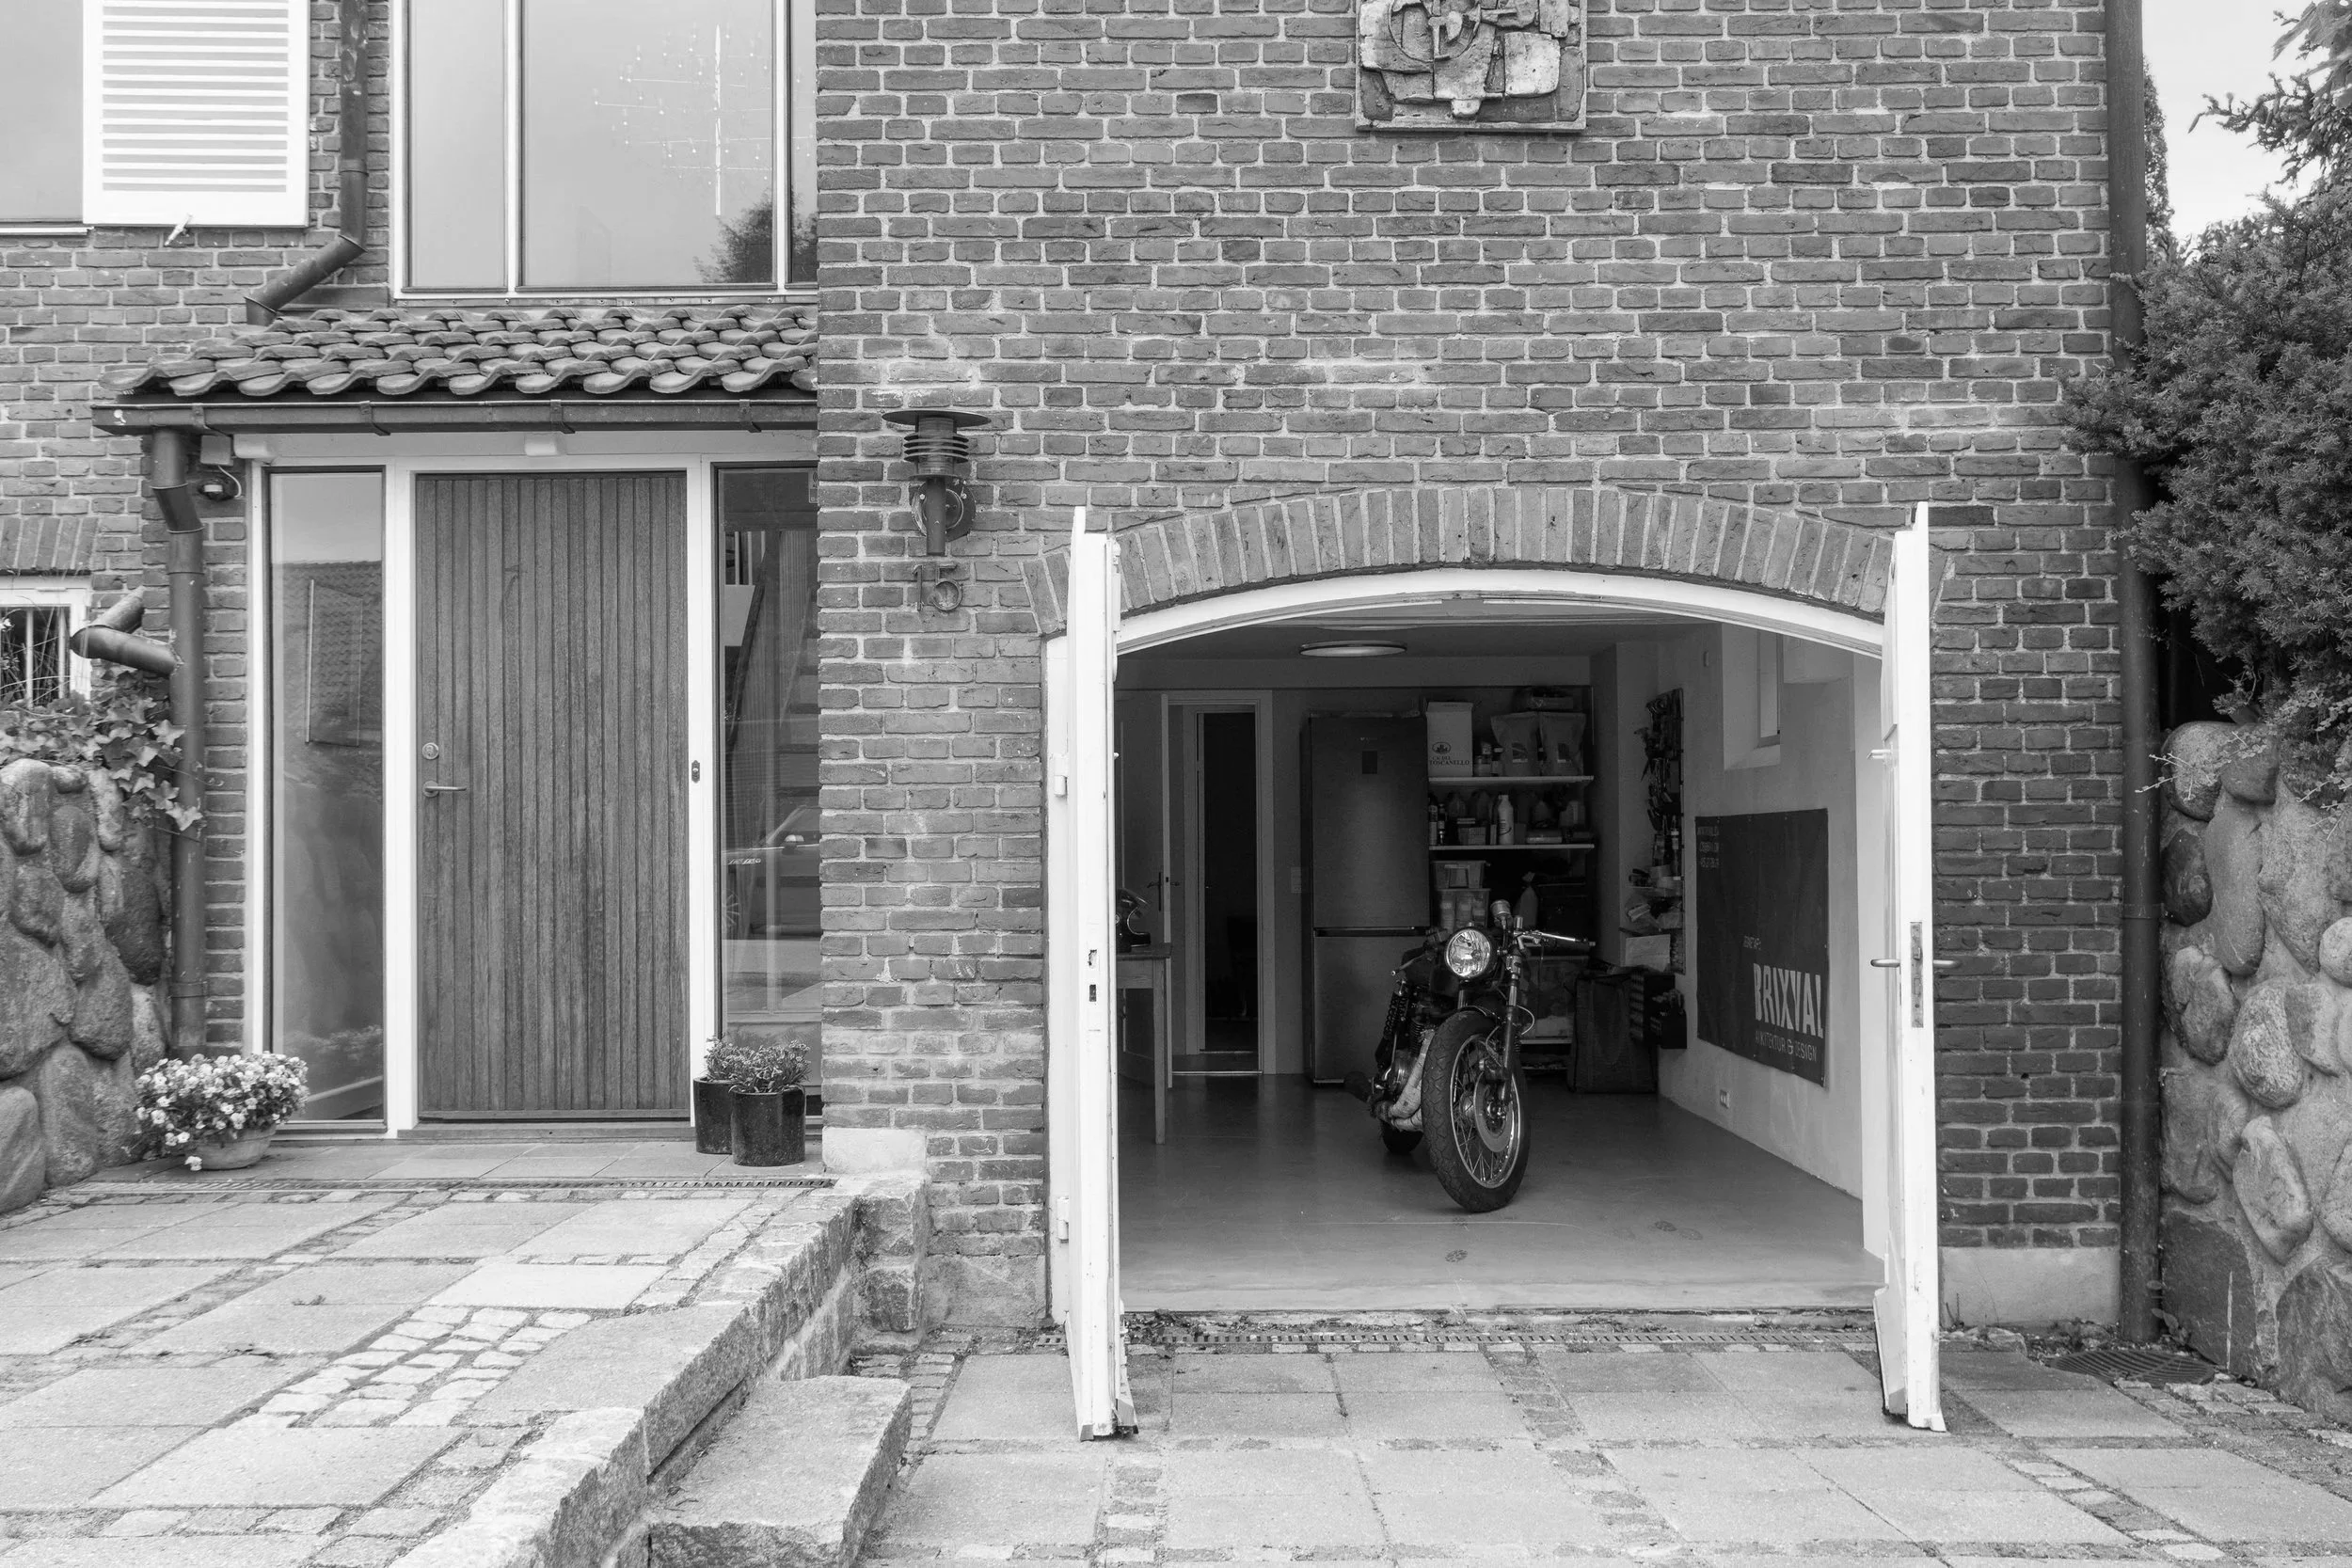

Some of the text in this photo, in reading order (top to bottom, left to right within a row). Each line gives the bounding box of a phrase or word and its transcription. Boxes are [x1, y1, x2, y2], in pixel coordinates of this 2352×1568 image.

[910, 563, 962, 611] 15
[1753, 962, 1824, 1039] BRIXVAL
[1795, 1040, 1817, 1062] DESIGN
